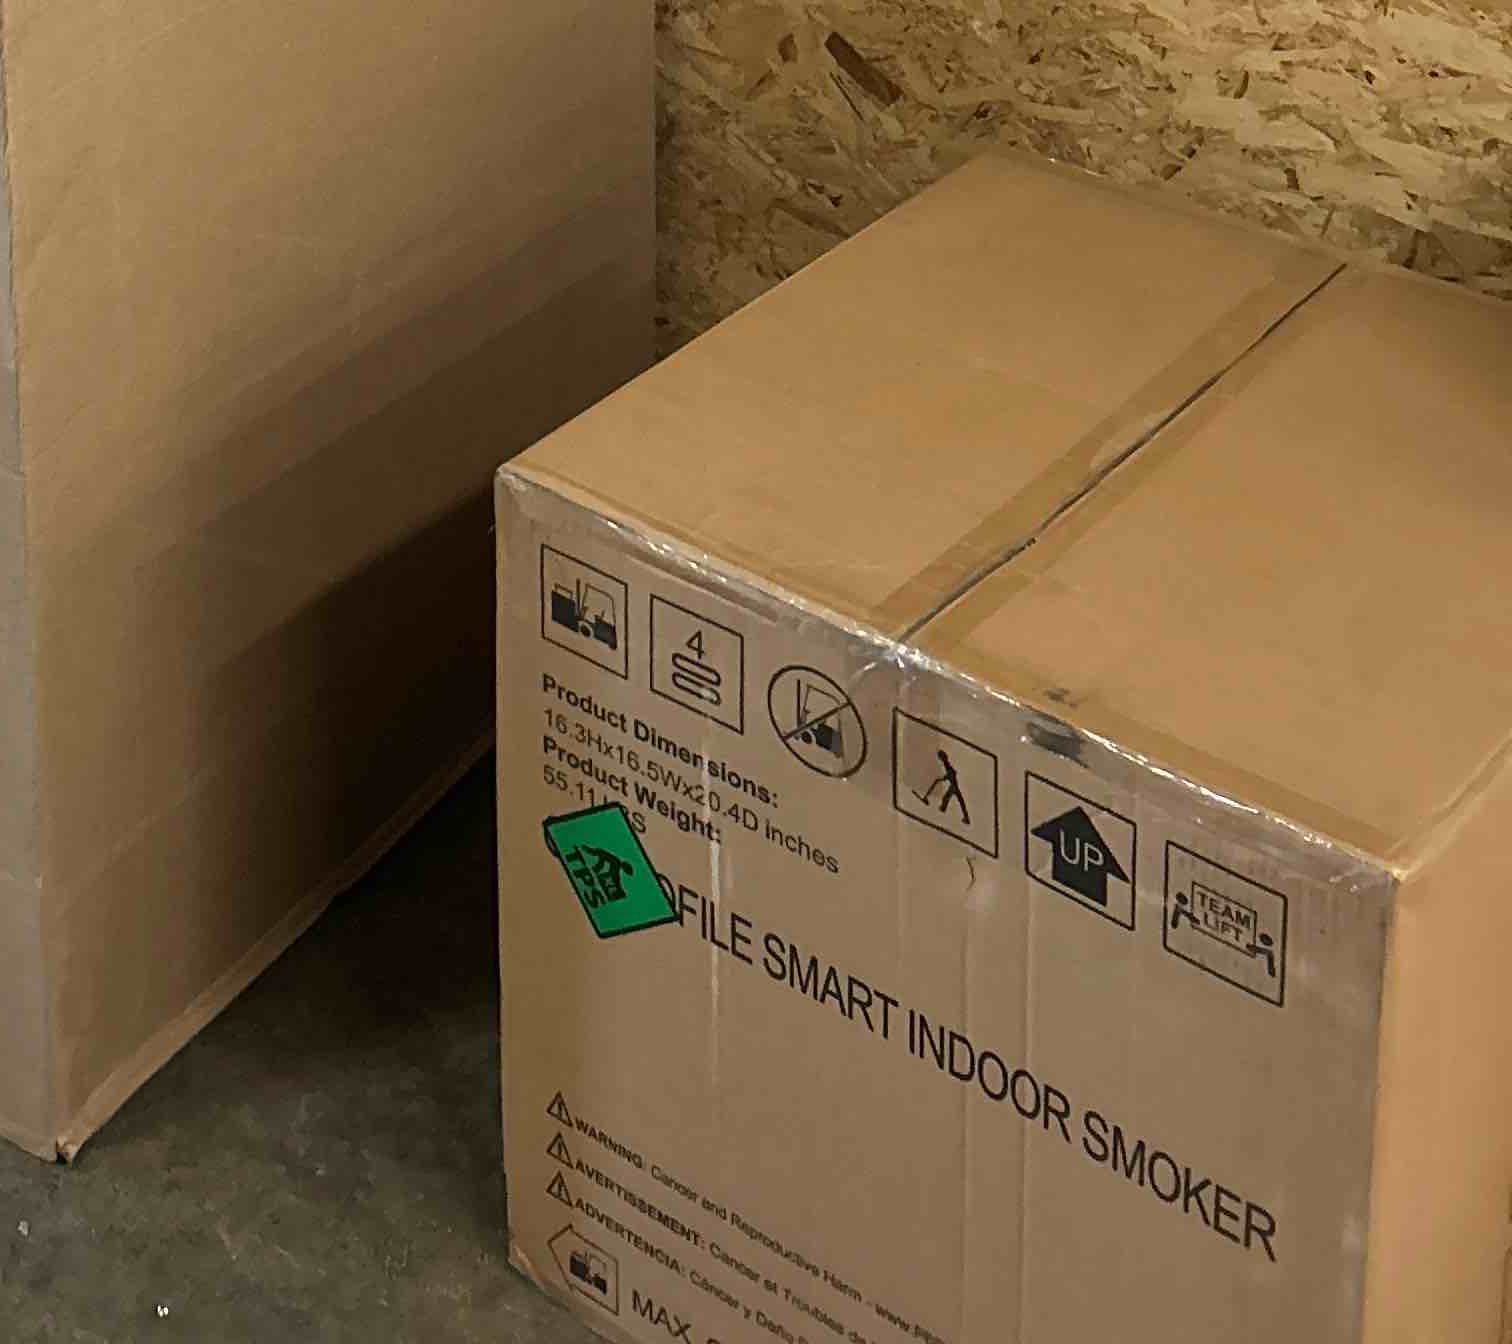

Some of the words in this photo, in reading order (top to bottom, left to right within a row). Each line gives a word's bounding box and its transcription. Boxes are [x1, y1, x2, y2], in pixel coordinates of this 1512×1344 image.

[685, 629, 705, 660] 4
[542, 673, 627, 734] Product
[633, 718, 779, 808] Dimensions:
[543, 735, 629, 798] Product
[634, 783, 721, 845] Weight:
[565, 845, 606, 909] TPS
[765, 821, 839, 874] inches
[1059, 827, 1104, 873] UP
[1196, 890, 1252, 930] TEAM
[1203, 913, 1243, 942] LIFT
[763, 933, 899, 1039] SMART
[908, 1009, 1072, 1143] INDOOR
[1082, 1110, 1278, 1262] SMOKER
[575, 1159, 706, 1250] AVERTISSEMENT:
[709, 1242, 761, 1282] Cancer
[575, 1197, 686, 1277] ADVERTENCIA:
[650, 1164, 697, 1203] Cancer
[701, 1196, 728, 1221] and
[730, 1211, 820, 1277] Reproductive
